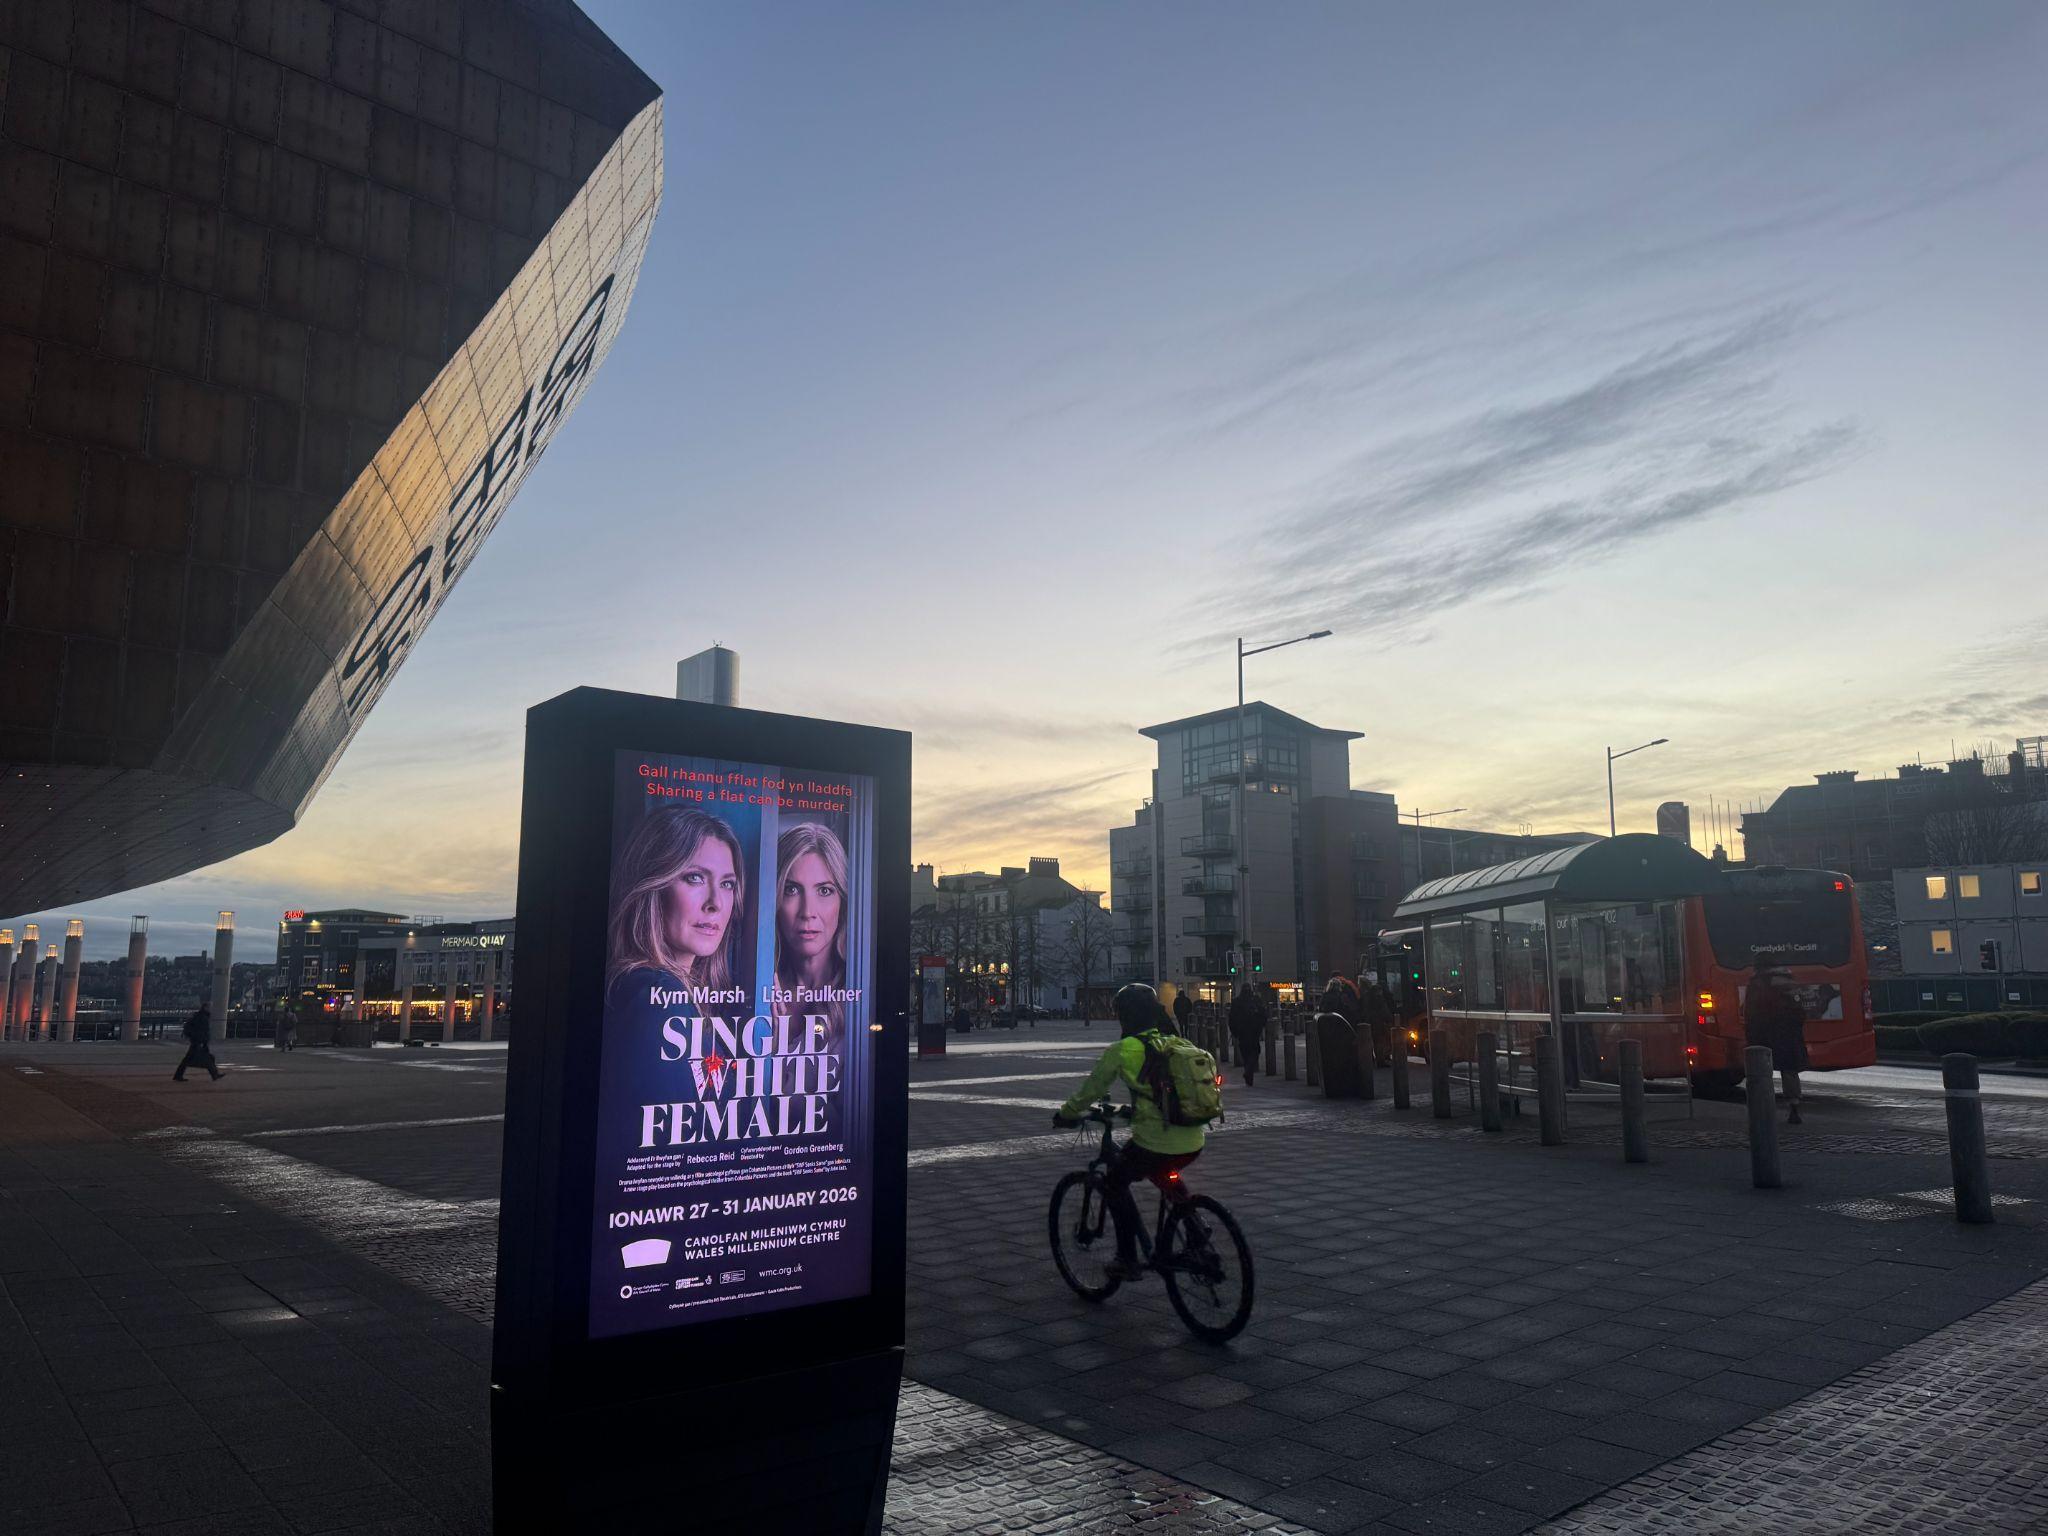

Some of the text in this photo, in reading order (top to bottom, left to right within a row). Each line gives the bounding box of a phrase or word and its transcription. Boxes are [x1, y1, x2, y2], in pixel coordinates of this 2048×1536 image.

[639, 764, 668, 778] Gall
[673, 768, 723, 784] rhannu
[727, 773, 758, 788] fflat
[762, 776, 785, 791] fod
[789, 782, 804, 793] yn
[647, 783, 703, 802] Sharing
[708, 791, 715, 800] a
[721, 789, 744, 803] flat
[748, 795, 774, 806] can
[777, 796, 793, 808] be
[441, 934, 506, 948] MERMAID QUAY
[650, 986, 745, 1009] Kym Marsh
[762, 985, 862, 1003] Lisa Faulkner
[660, 1014, 829, 1061] SINGLE
[688, 1054, 841, 1101] WHITE
[639, 1094, 828, 1148] FEMALE
[687, 1151, 735, 1165] Rebecca Reid
[783, 1141, 844, 1155] Gordon Greenberg
[609, 1205, 685, 1229] IONAWR
[689, 1202, 709, 1220] 27
[722, 1199, 739, 1216] 31
[743, 1190, 817, 1214] JANUARY
[819, 1186, 858, 1205] 2026
[685, 1218, 847, 1248] CANOLFAN MILENIWM CYMRU
[685, 1231, 840, 1261] WALES MILLENNIUM CENTRE
[758, 1263, 803, 1278] wmc.org.uk
